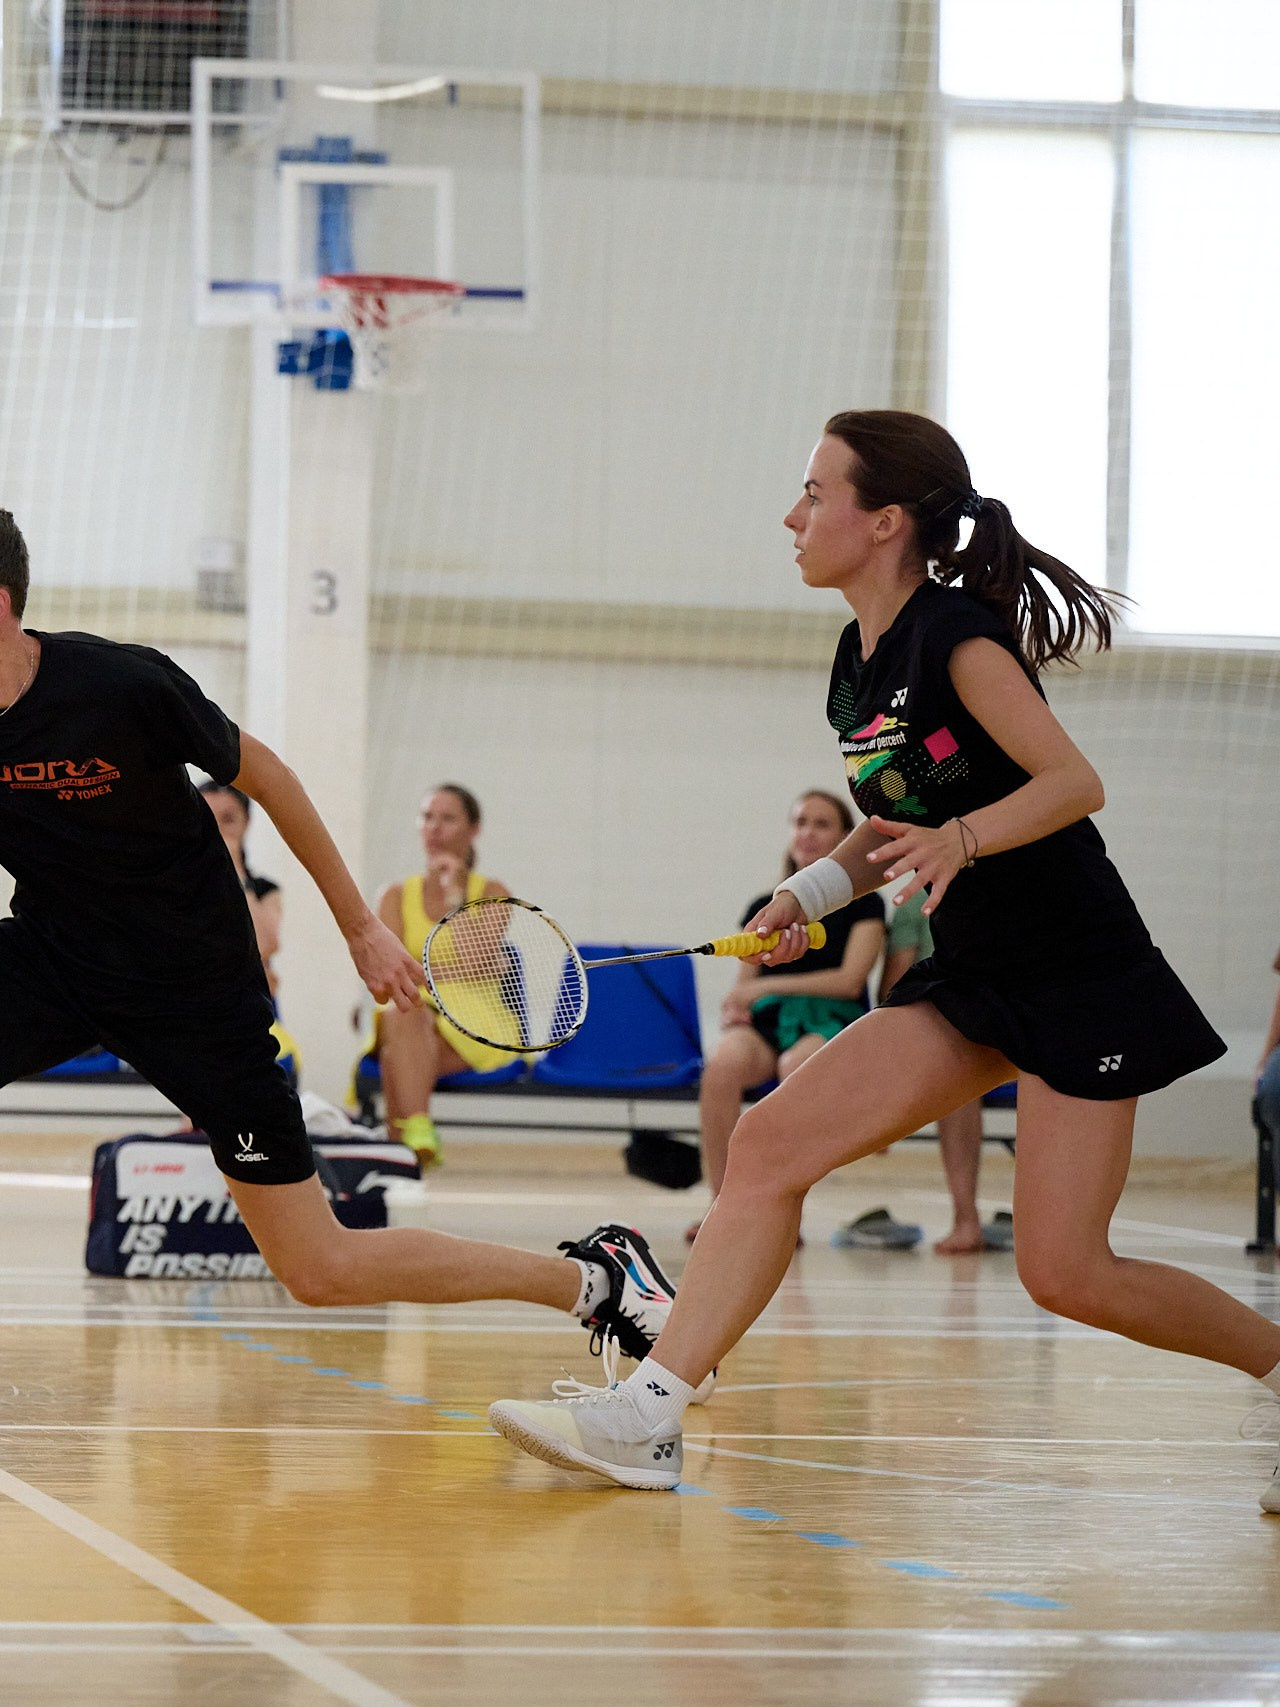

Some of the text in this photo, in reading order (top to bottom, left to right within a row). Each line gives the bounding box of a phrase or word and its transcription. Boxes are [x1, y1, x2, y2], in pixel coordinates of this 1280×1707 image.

[310, 570, 337, 615] 3
[877, 731, 906, 750] percent
[57, 779, 80, 787] DUAL
[83, 772, 118, 784] DESIGN
[75, 784, 112, 800] YONEX
[119, 1223, 167, 1253] IS
